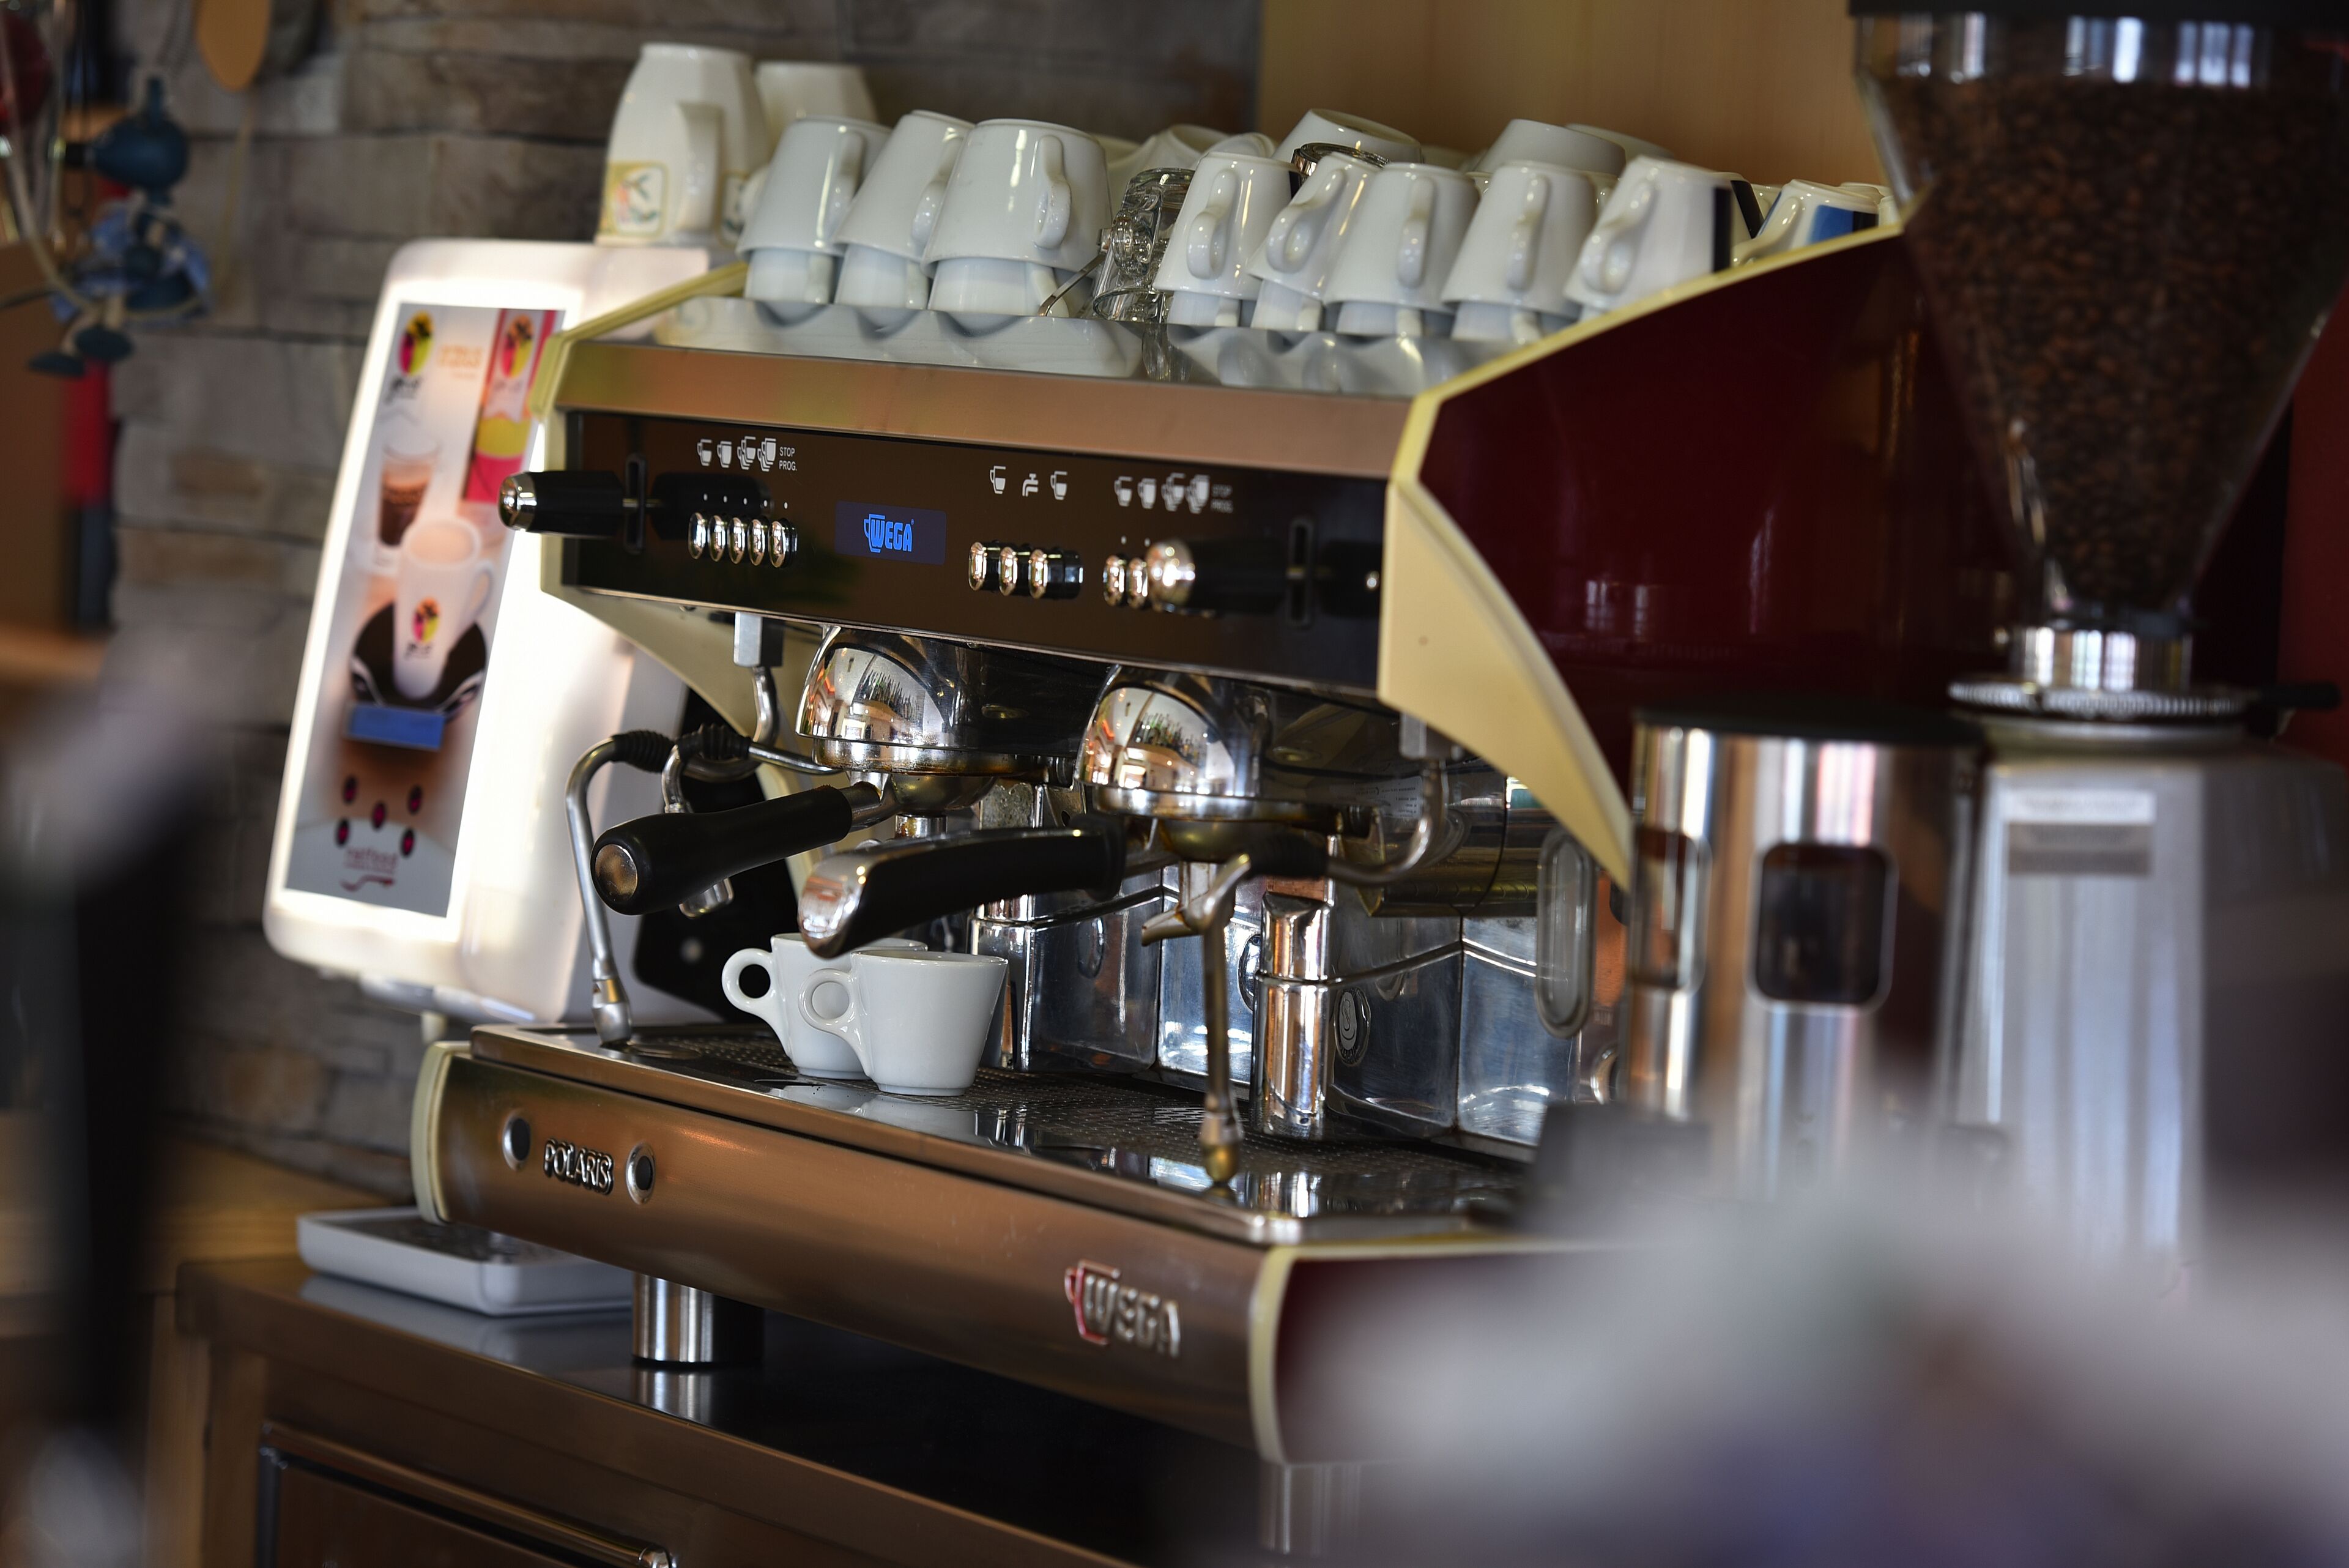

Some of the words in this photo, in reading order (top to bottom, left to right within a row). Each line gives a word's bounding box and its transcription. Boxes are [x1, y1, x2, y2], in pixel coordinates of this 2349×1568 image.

[779, 447, 795, 457] STOP
[779, 459, 798, 471] PROG.
[870, 519, 912, 552] WEGA
[544, 1138, 614, 1195] POLARIS
[1085, 1274, 1181, 1358] WEGA
